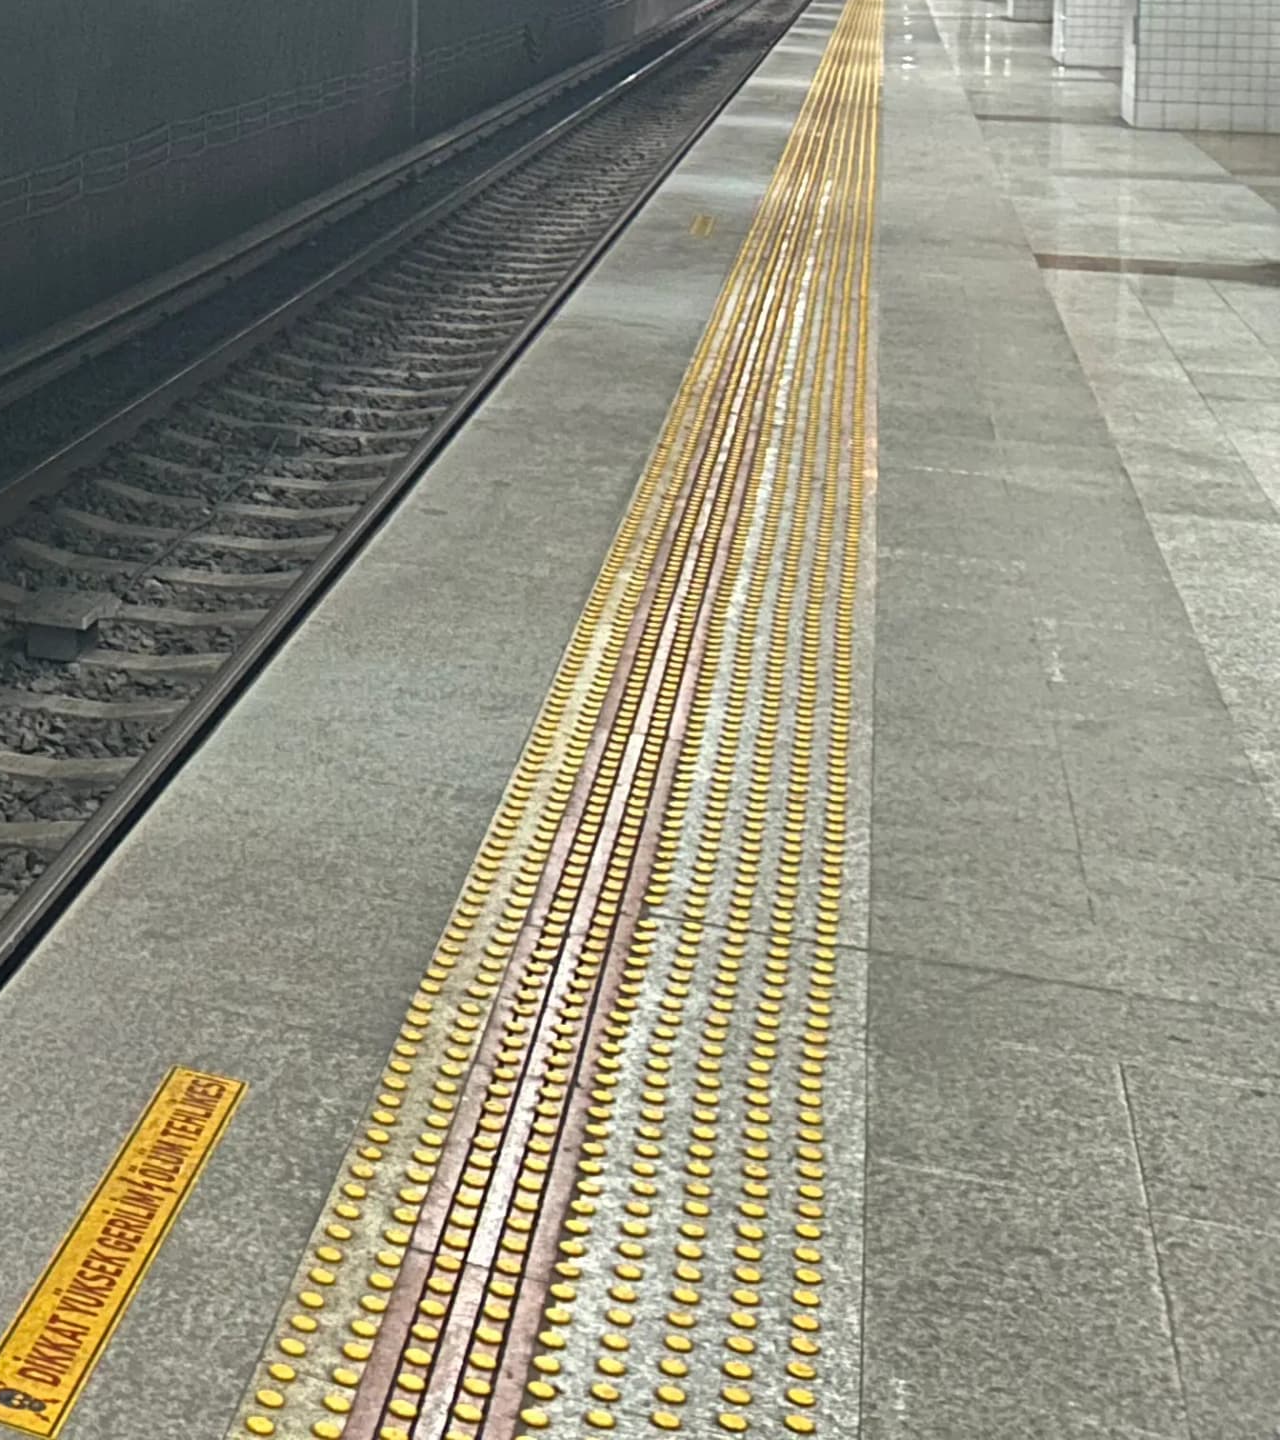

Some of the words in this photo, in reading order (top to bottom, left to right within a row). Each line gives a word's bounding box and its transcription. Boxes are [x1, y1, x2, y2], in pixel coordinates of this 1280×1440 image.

[127, 1139, 193, 1183] ÖLÜM
[96, 1188, 165, 1253] GERİLİM
[53, 1248, 131, 1317] YÜKSEK
[12, 1313, 90, 1387] DİKKAT
